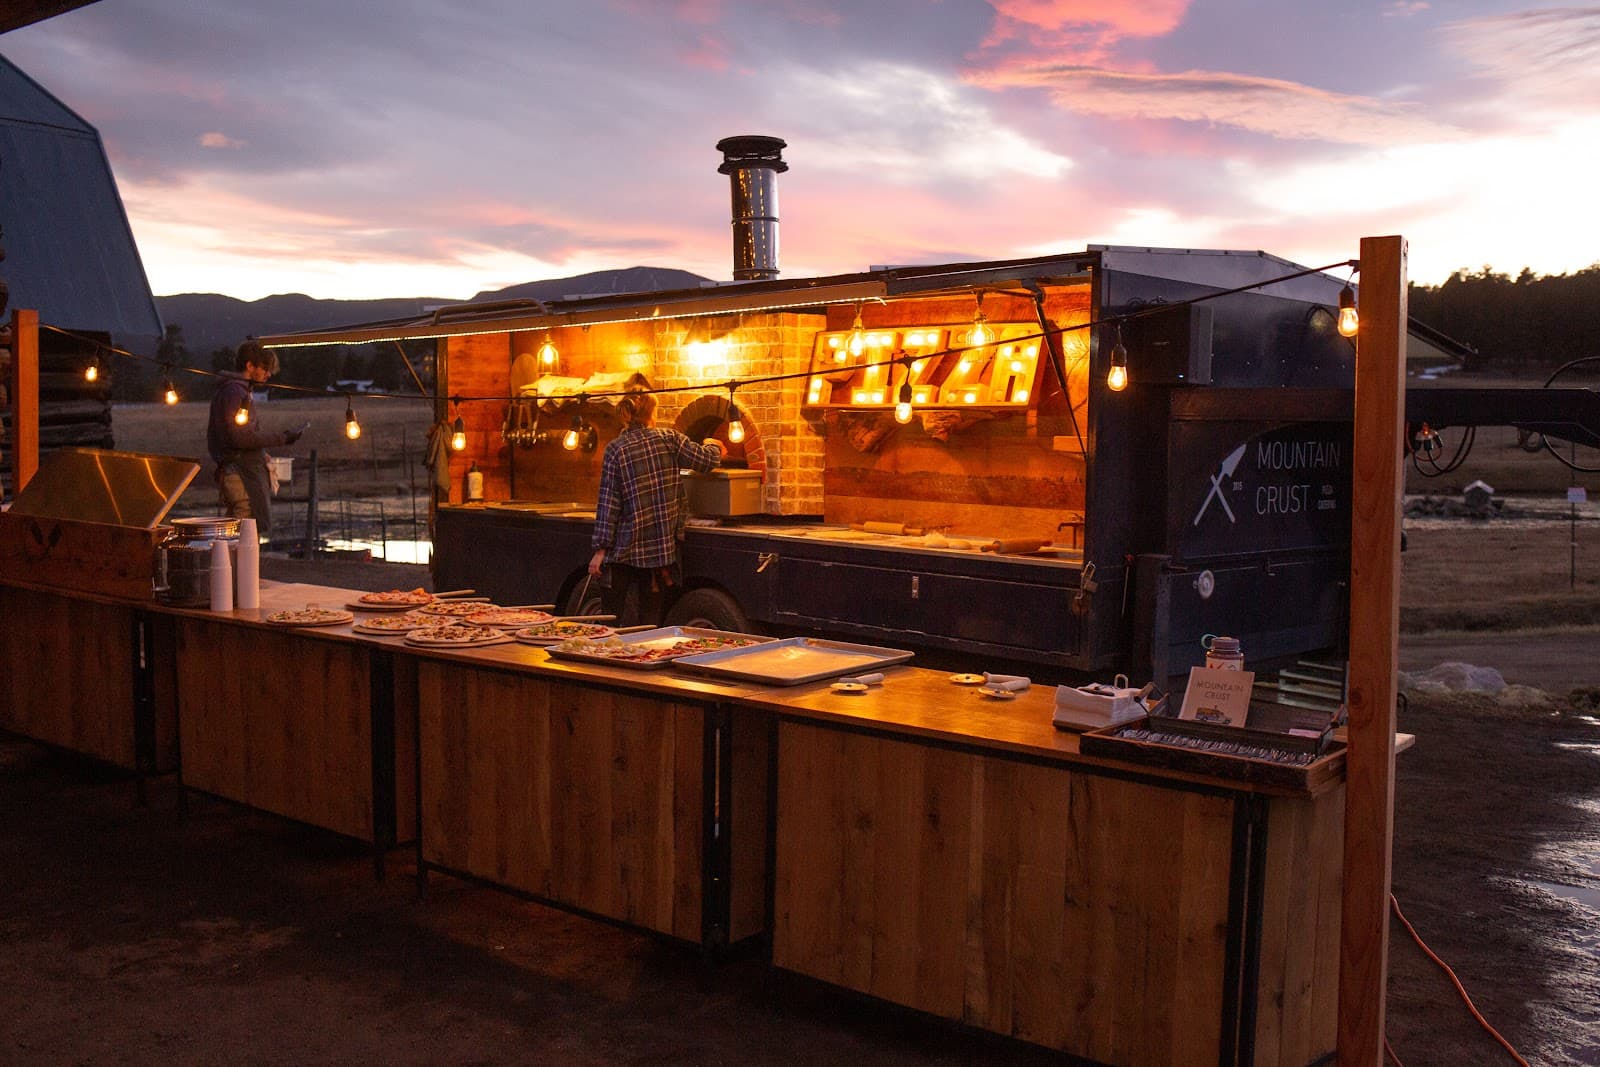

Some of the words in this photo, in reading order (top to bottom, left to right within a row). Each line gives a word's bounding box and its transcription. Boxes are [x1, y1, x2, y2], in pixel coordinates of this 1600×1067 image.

[807, 327, 1041, 405] PIZZA
[1257, 442, 1340, 469] MOUNTAIN
[1256, 484, 1311, 514] CRUST
[1196, 680, 1244, 692] MOUNTAIN
[1204, 691, 1231, 701] CRUST
